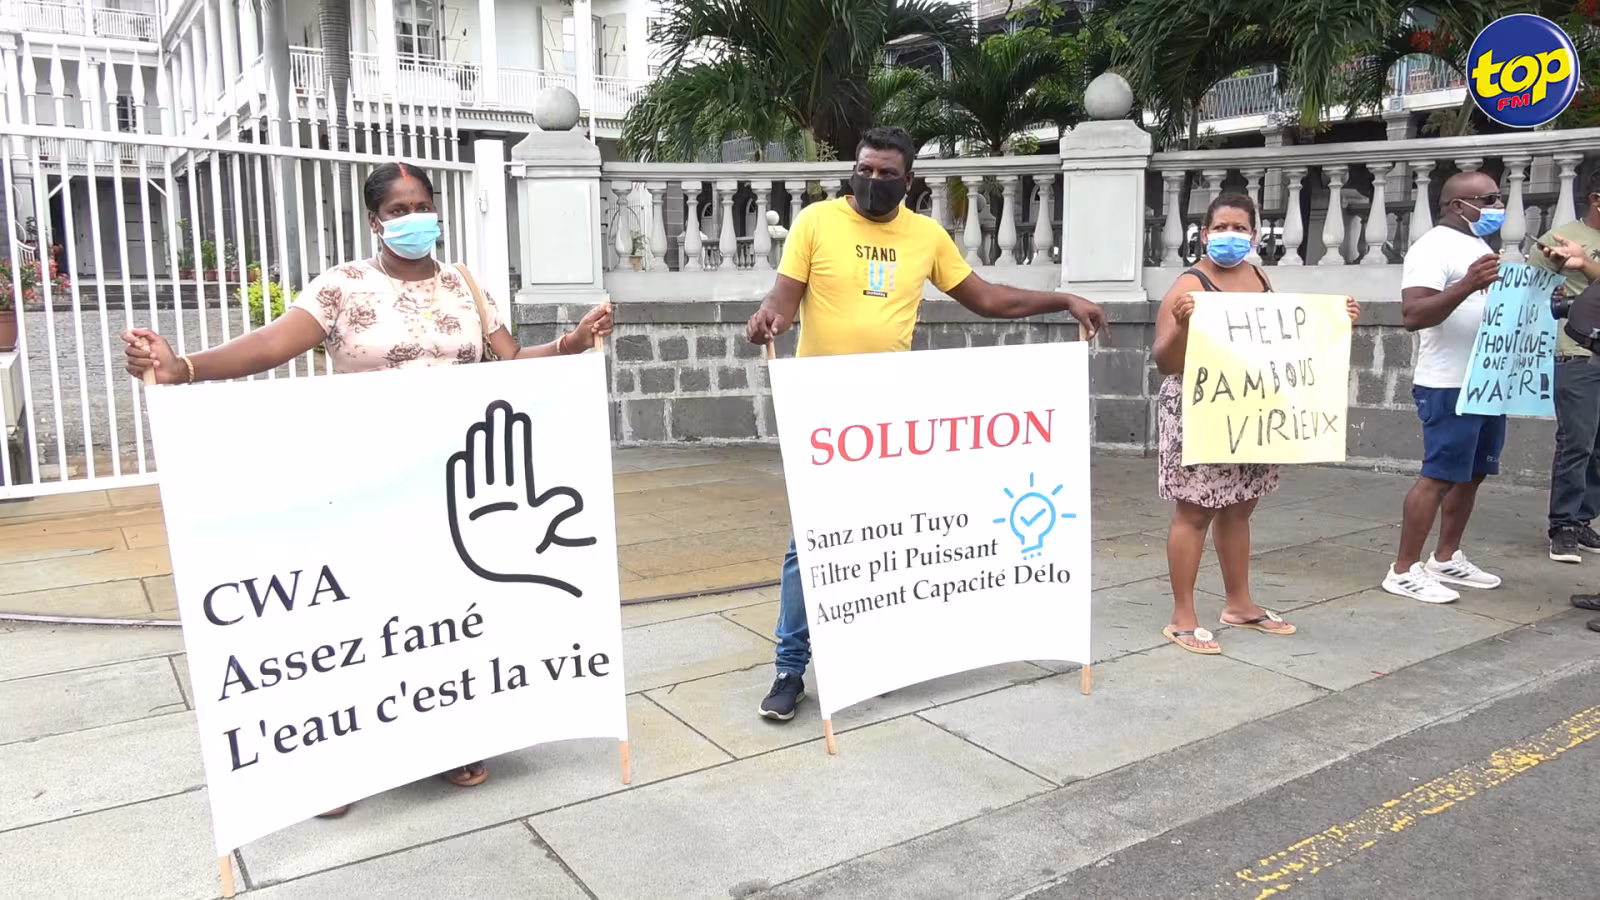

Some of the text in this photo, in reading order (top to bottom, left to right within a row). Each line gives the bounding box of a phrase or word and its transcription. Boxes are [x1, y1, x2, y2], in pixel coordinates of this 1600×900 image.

[856, 244, 896, 262] STAND
[1226, 306, 1306, 344] HELP
[1192, 357, 1315, 406] BAMBOUS
[810, 409, 1056, 466] SOLUTION
[806, 512, 969, 551] Sanz nou Tuyo
[809, 538, 999, 589] Filtre pli Puissant
[202, 564, 351, 627] CWA
[815, 562, 1072, 625] Augment Capacité Délo
[217, 602, 485, 702] Assez fané
[222, 642, 611, 773] L'eau c'est la vie
